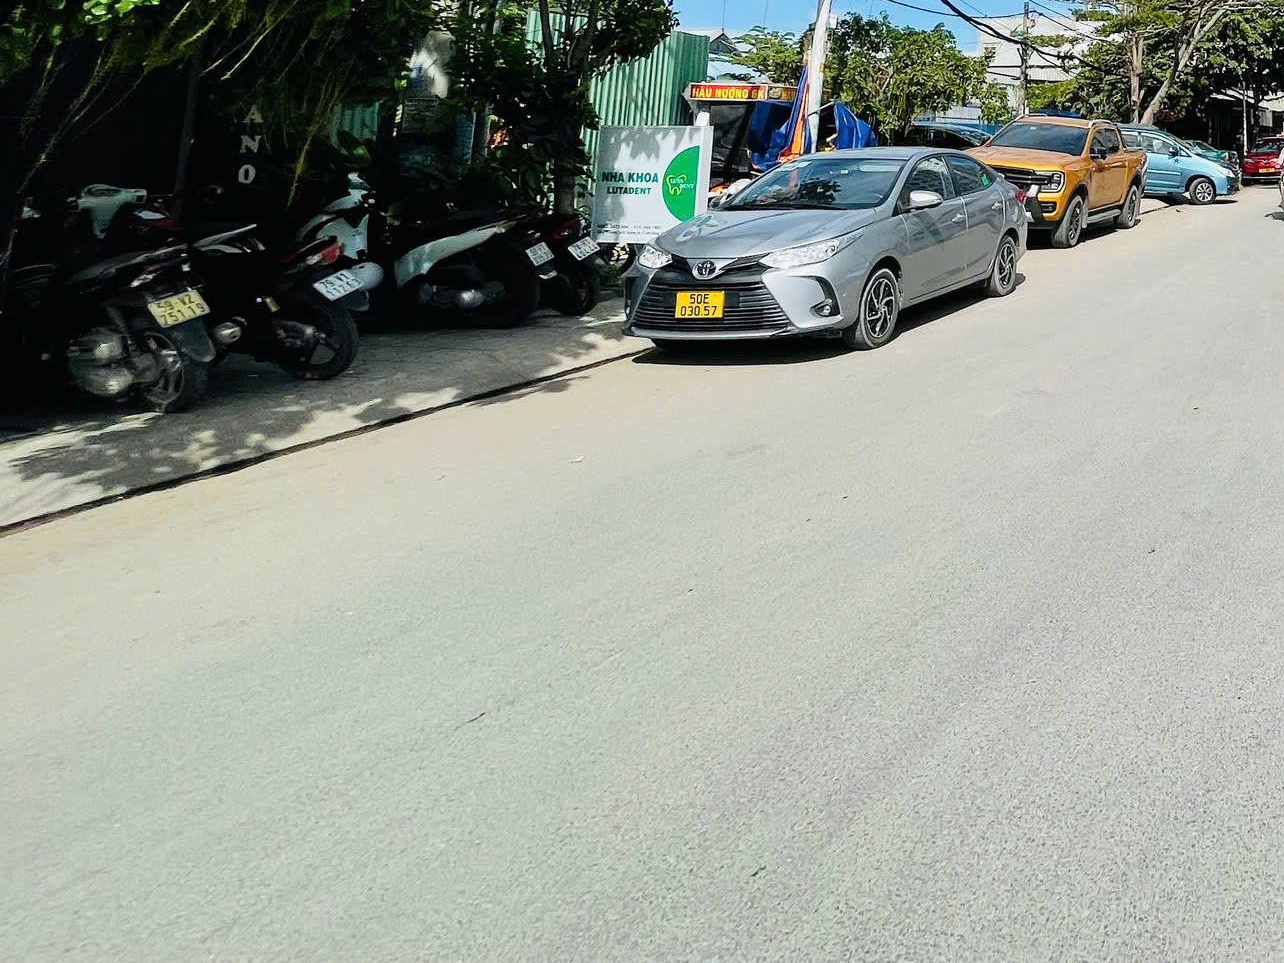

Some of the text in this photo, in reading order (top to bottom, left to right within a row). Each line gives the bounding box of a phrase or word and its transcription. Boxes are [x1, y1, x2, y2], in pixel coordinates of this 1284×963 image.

[601, 172, 659, 183] NHA KHOA
[607, 186, 651, 195] LUTADENT
[689, 293, 710, 304] 50E
[680, 305, 718, 316] 030.57
